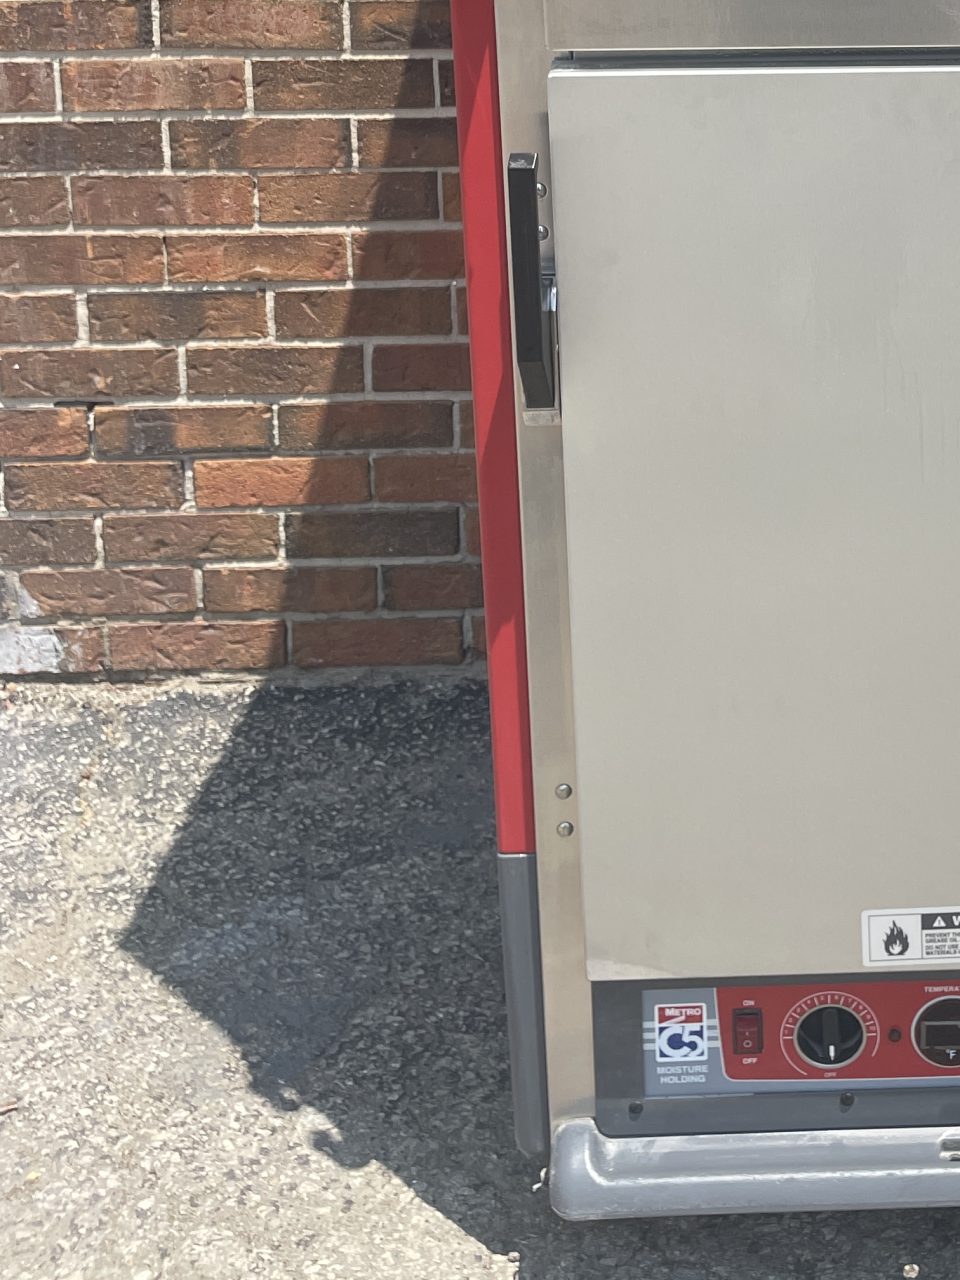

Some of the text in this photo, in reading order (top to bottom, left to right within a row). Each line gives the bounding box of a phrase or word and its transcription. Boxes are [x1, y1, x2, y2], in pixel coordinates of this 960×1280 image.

[664, 1007, 702, 1017] METRO
[660, 1024, 704, 1058] C5
[742, 1057, 758, 1065] OFF
[656, 1064, 709, 1074] MOISTURE
[660, 1074, 707, 1084] HOLDING
